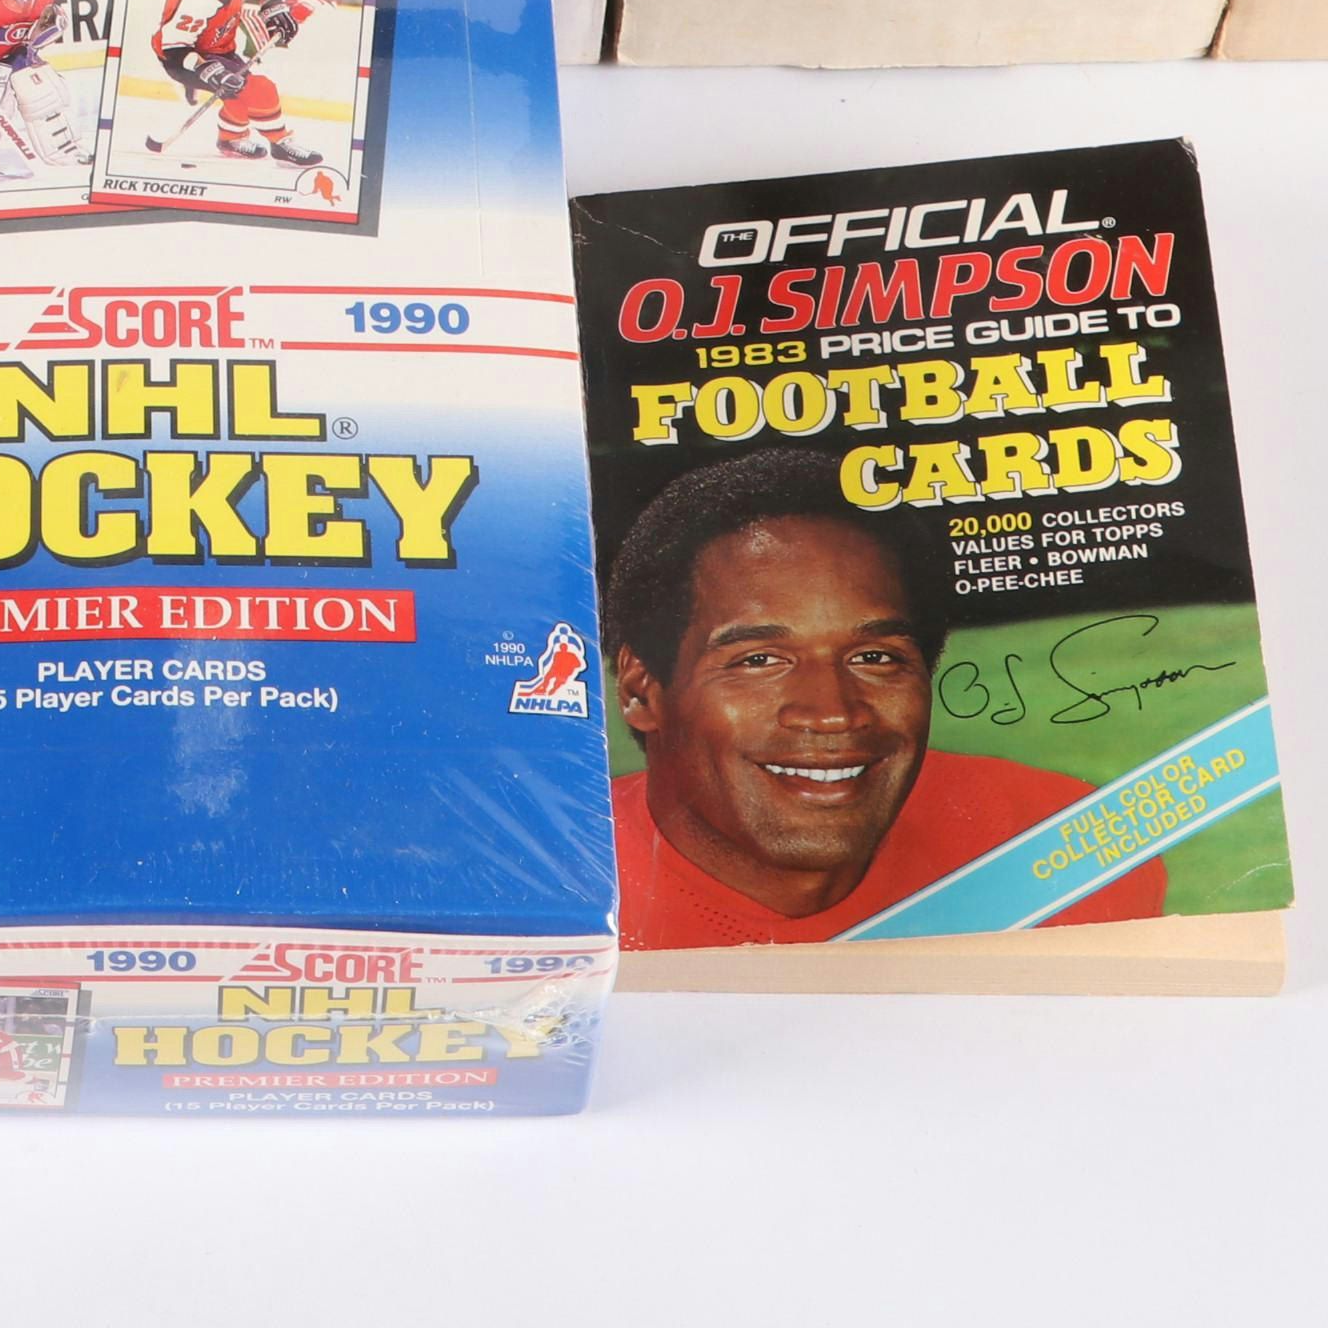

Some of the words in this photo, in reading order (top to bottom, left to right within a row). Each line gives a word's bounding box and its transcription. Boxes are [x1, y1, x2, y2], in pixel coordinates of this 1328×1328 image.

[103, 179, 139, 193] RICK
[142, 182, 208, 197] TOCCHET
[698, 189, 1104, 269] OFFICIAL
[721, 230, 754, 243] THE
[760, 232, 1176, 335] SIMPSON
[38, 285, 245, 349] SCORE
[344, 301, 471, 335] 1990
[695, 340, 808, 369] 1983
[820, 325, 955, 360] PRICE
[965, 313, 1110, 348] GUIDE
[1118, 303, 1182, 329] TO
[630, 341, 1173, 448] FOOTBALL
[839, 418, 1183, 511] CARDS
[948, 511, 1033, 538] 20,000
[1041, 501, 1186, 529] COLLECTORS
[952, 535, 1035, 557] VALUES
[1041, 528, 1087, 548] FOR
[1092, 522, 1164, 543] TOPPS
[953, 555, 1022, 576] FLEER
[1046, 543, 1149, 567] BOWMAN
[954, 568, 1085, 595] O-PEE-CHEE
[158, 595, 401, 634] EDITION
[484, 654, 534, 667] NHLPA
[493, 642, 526, 654] 1990
[37, 660, 154, 683] PLAYER
[162, 658, 267, 682] CARDS
[15, 688, 103, 715] Player
[111, 686, 195, 709] Cards
[203, 686, 254, 708] Per
[260, 686, 339, 712] Pack)
[514, 698, 583, 714] NHLPA
[1032, 788, 1175, 880] COLLECTOR
[1177, 747, 1247, 795] CARD
[1059, 802, 1116, 843] FULL
[1119, 755, 1198, 809] COLOR
[1096, 794, 1207, 868] INCLUDED
[86, 949, 198, 972] 1990
[248, 943, 424, 983] SCORE
[218, 985, 444, 1023] NHL
[173, 1073, 331, 1089] PREMIER
[337, 1069, 489, 1086] EDITION
[228, 1091, 332, 1102] PLAYER
[344, 1090, 434, 1101] CARDS
[207, 1101, 282, 1113] Player
[288, 1101, 361, 1112] Cards
[368, 1101, 408, 1112] Per
